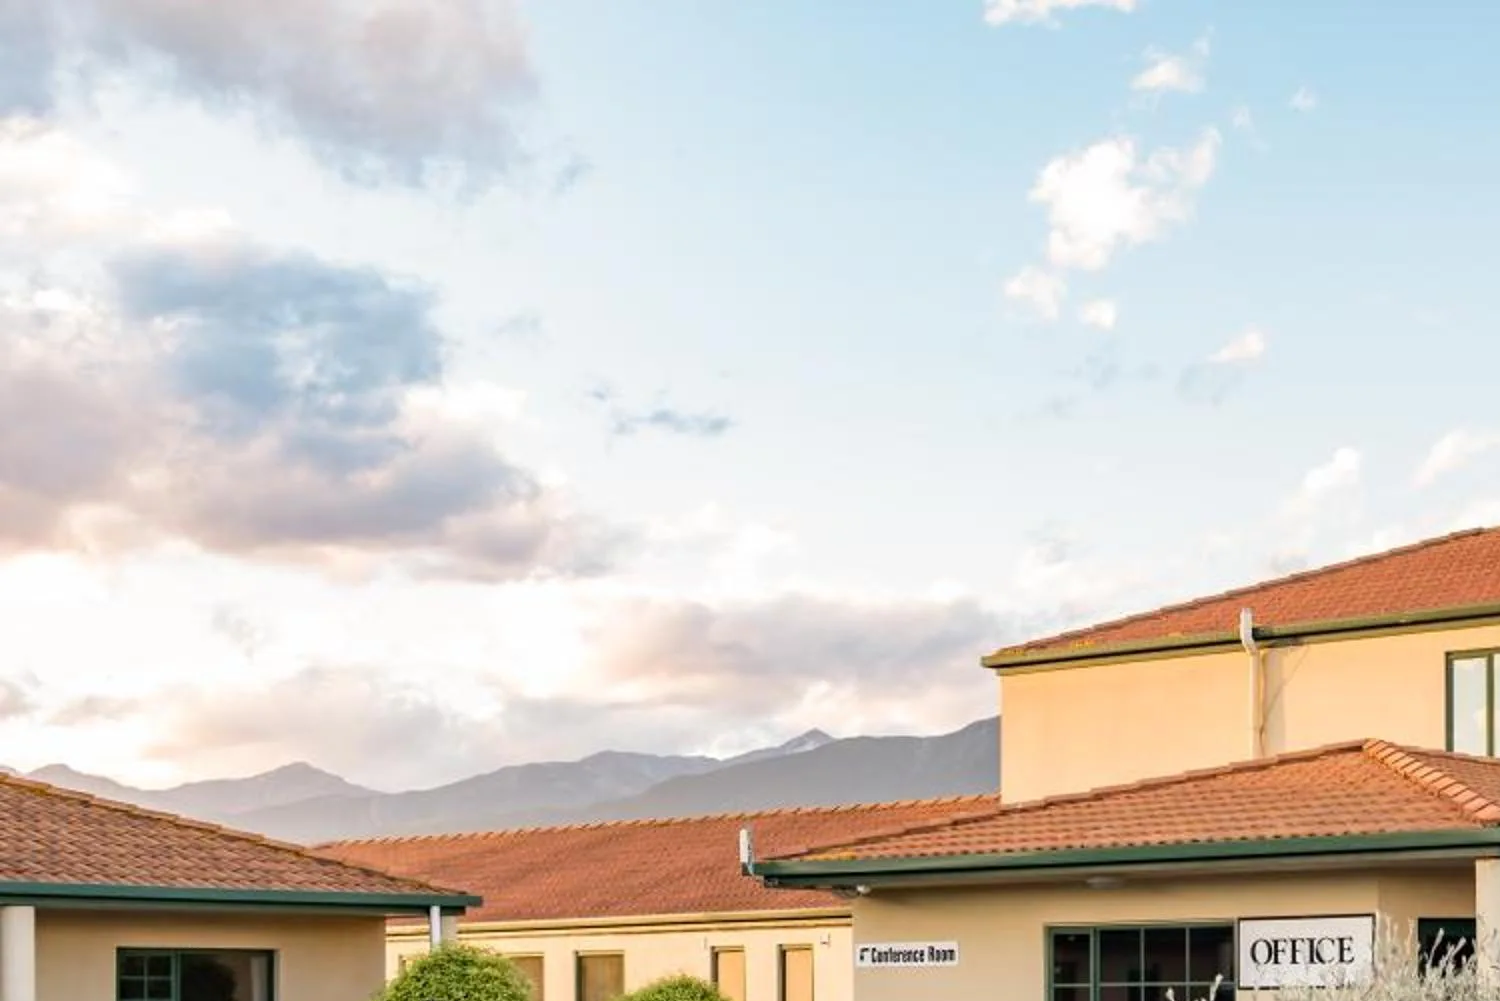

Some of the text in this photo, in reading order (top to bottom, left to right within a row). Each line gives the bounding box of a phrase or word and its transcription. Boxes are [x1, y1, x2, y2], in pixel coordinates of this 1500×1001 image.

[871, 945, 955, 963] Conference Room
[1249, 936, 1355, 965] OFFICE
